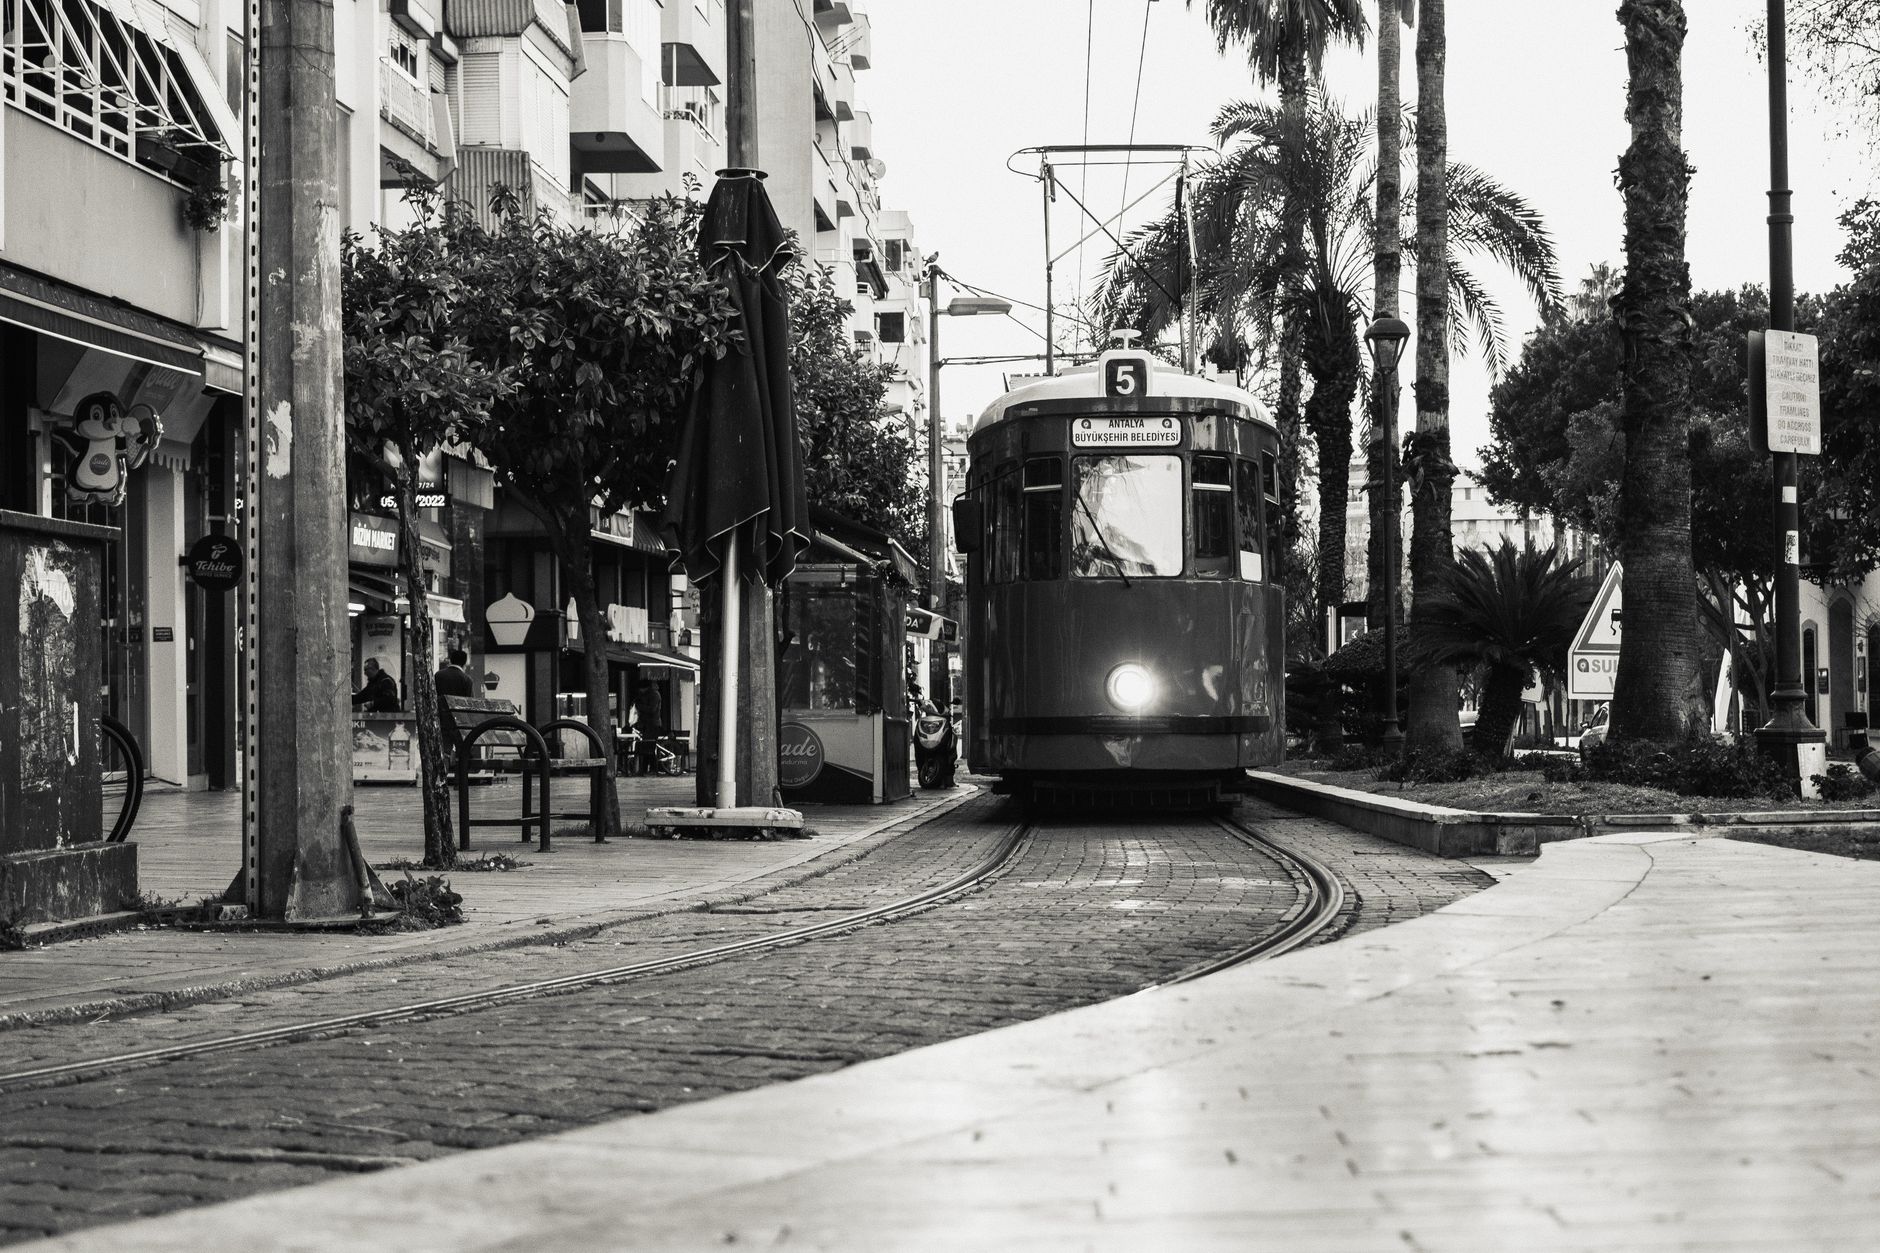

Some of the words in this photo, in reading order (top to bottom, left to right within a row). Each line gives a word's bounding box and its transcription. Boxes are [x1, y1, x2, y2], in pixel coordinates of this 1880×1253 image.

[1115, 365, 1136, 395] 5
[1108, 418, 1145, 429] ANTALYA
[1075, 430, 1129, 443] BÜYÜKŞEHİR
[1130, 431, 1179, 442] BELEDİYESİ
[353, 521, 372, 547] BİZİM
[371, 529, 396, 551] MARKET
[195, 560, 236, 572] Tchibo
[781, 735, 817, 757] ade
